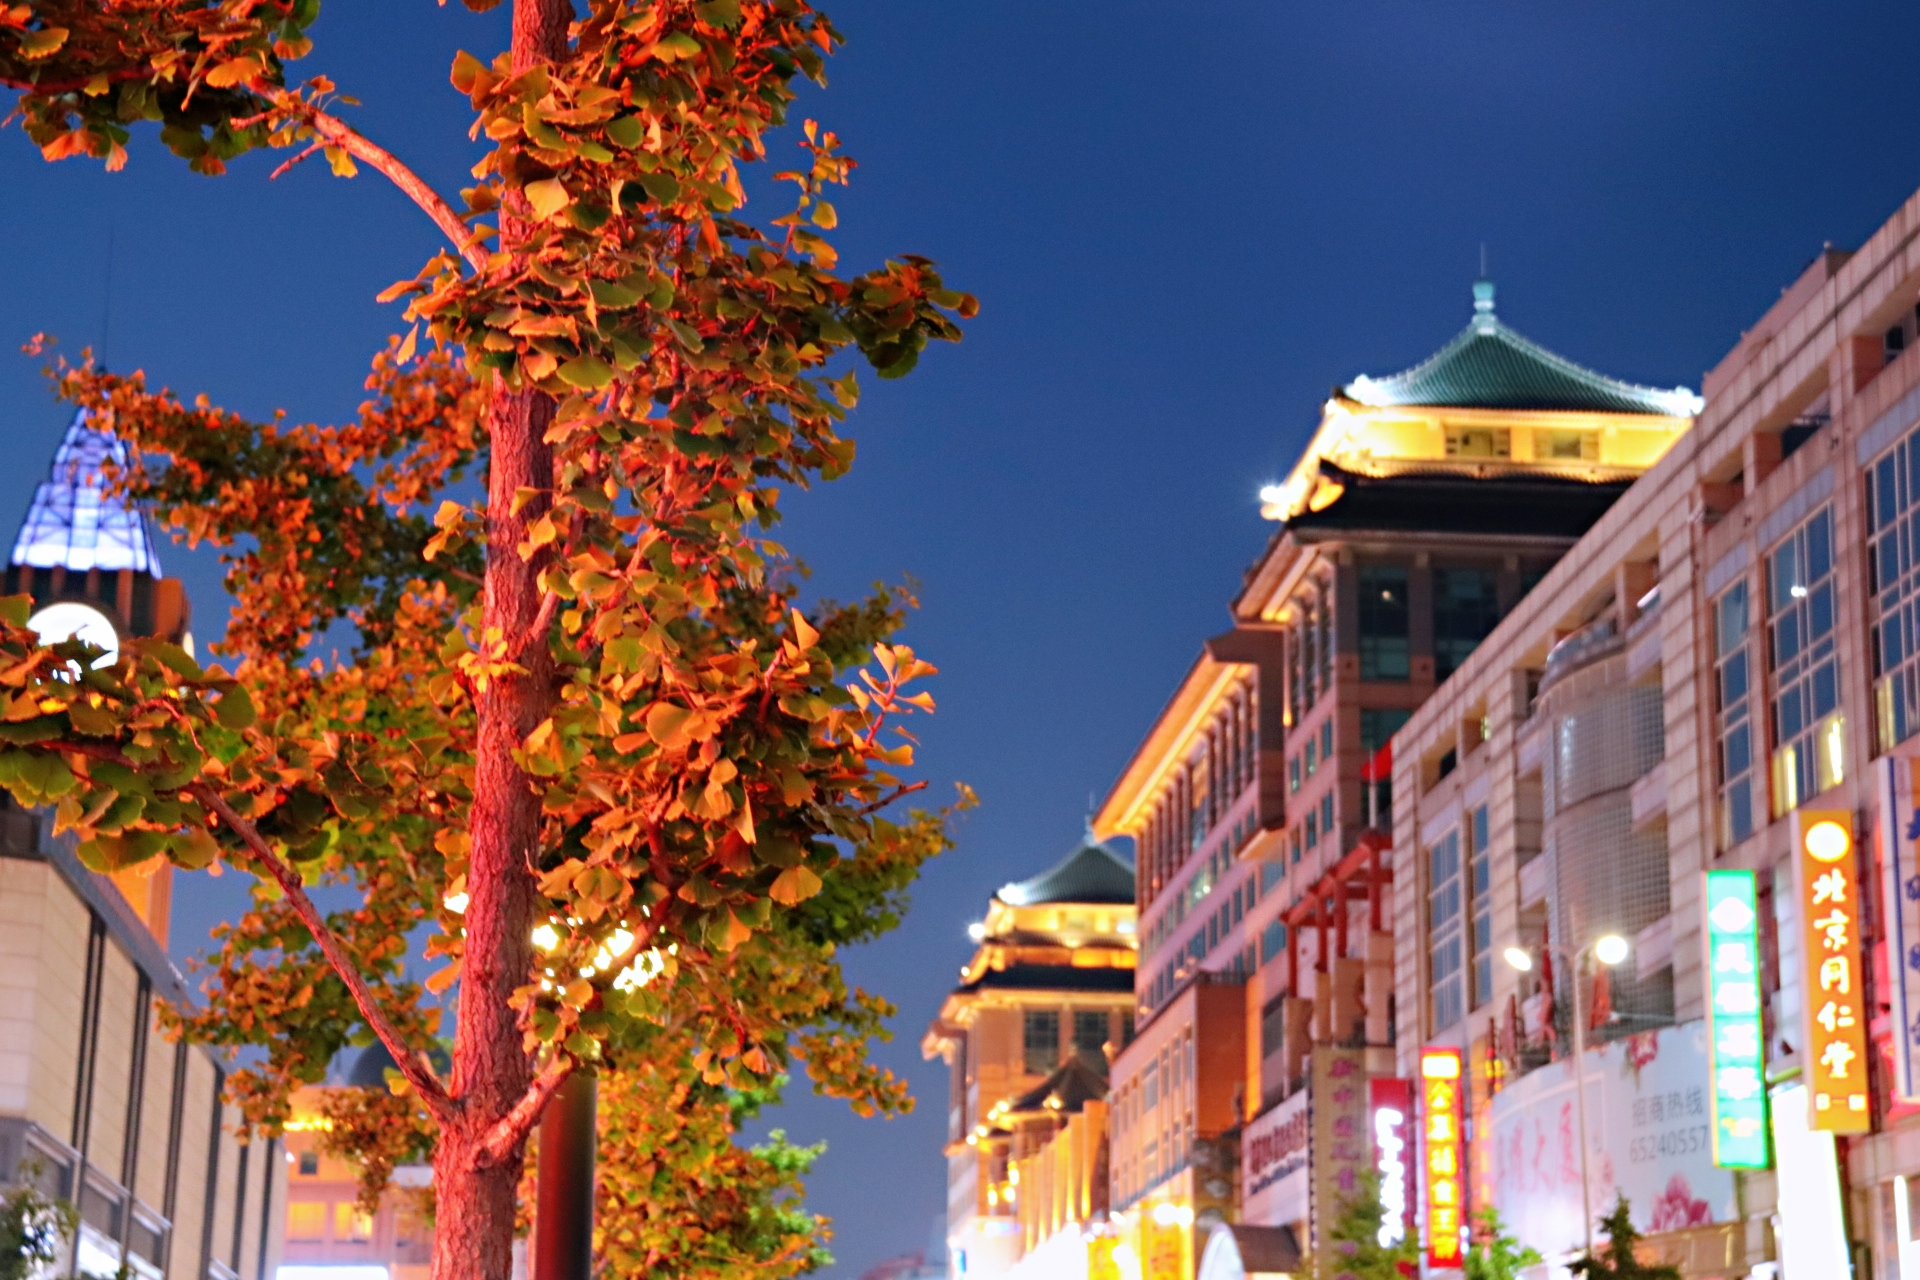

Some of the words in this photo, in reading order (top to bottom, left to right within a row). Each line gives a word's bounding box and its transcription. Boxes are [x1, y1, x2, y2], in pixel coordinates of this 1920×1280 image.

[1812, 868, 1856, 1079] 北京同仁堂
[1631, 1086, 1703, 1128] 招商热线
[1629, 1125, 1709, 1164] 65240557
